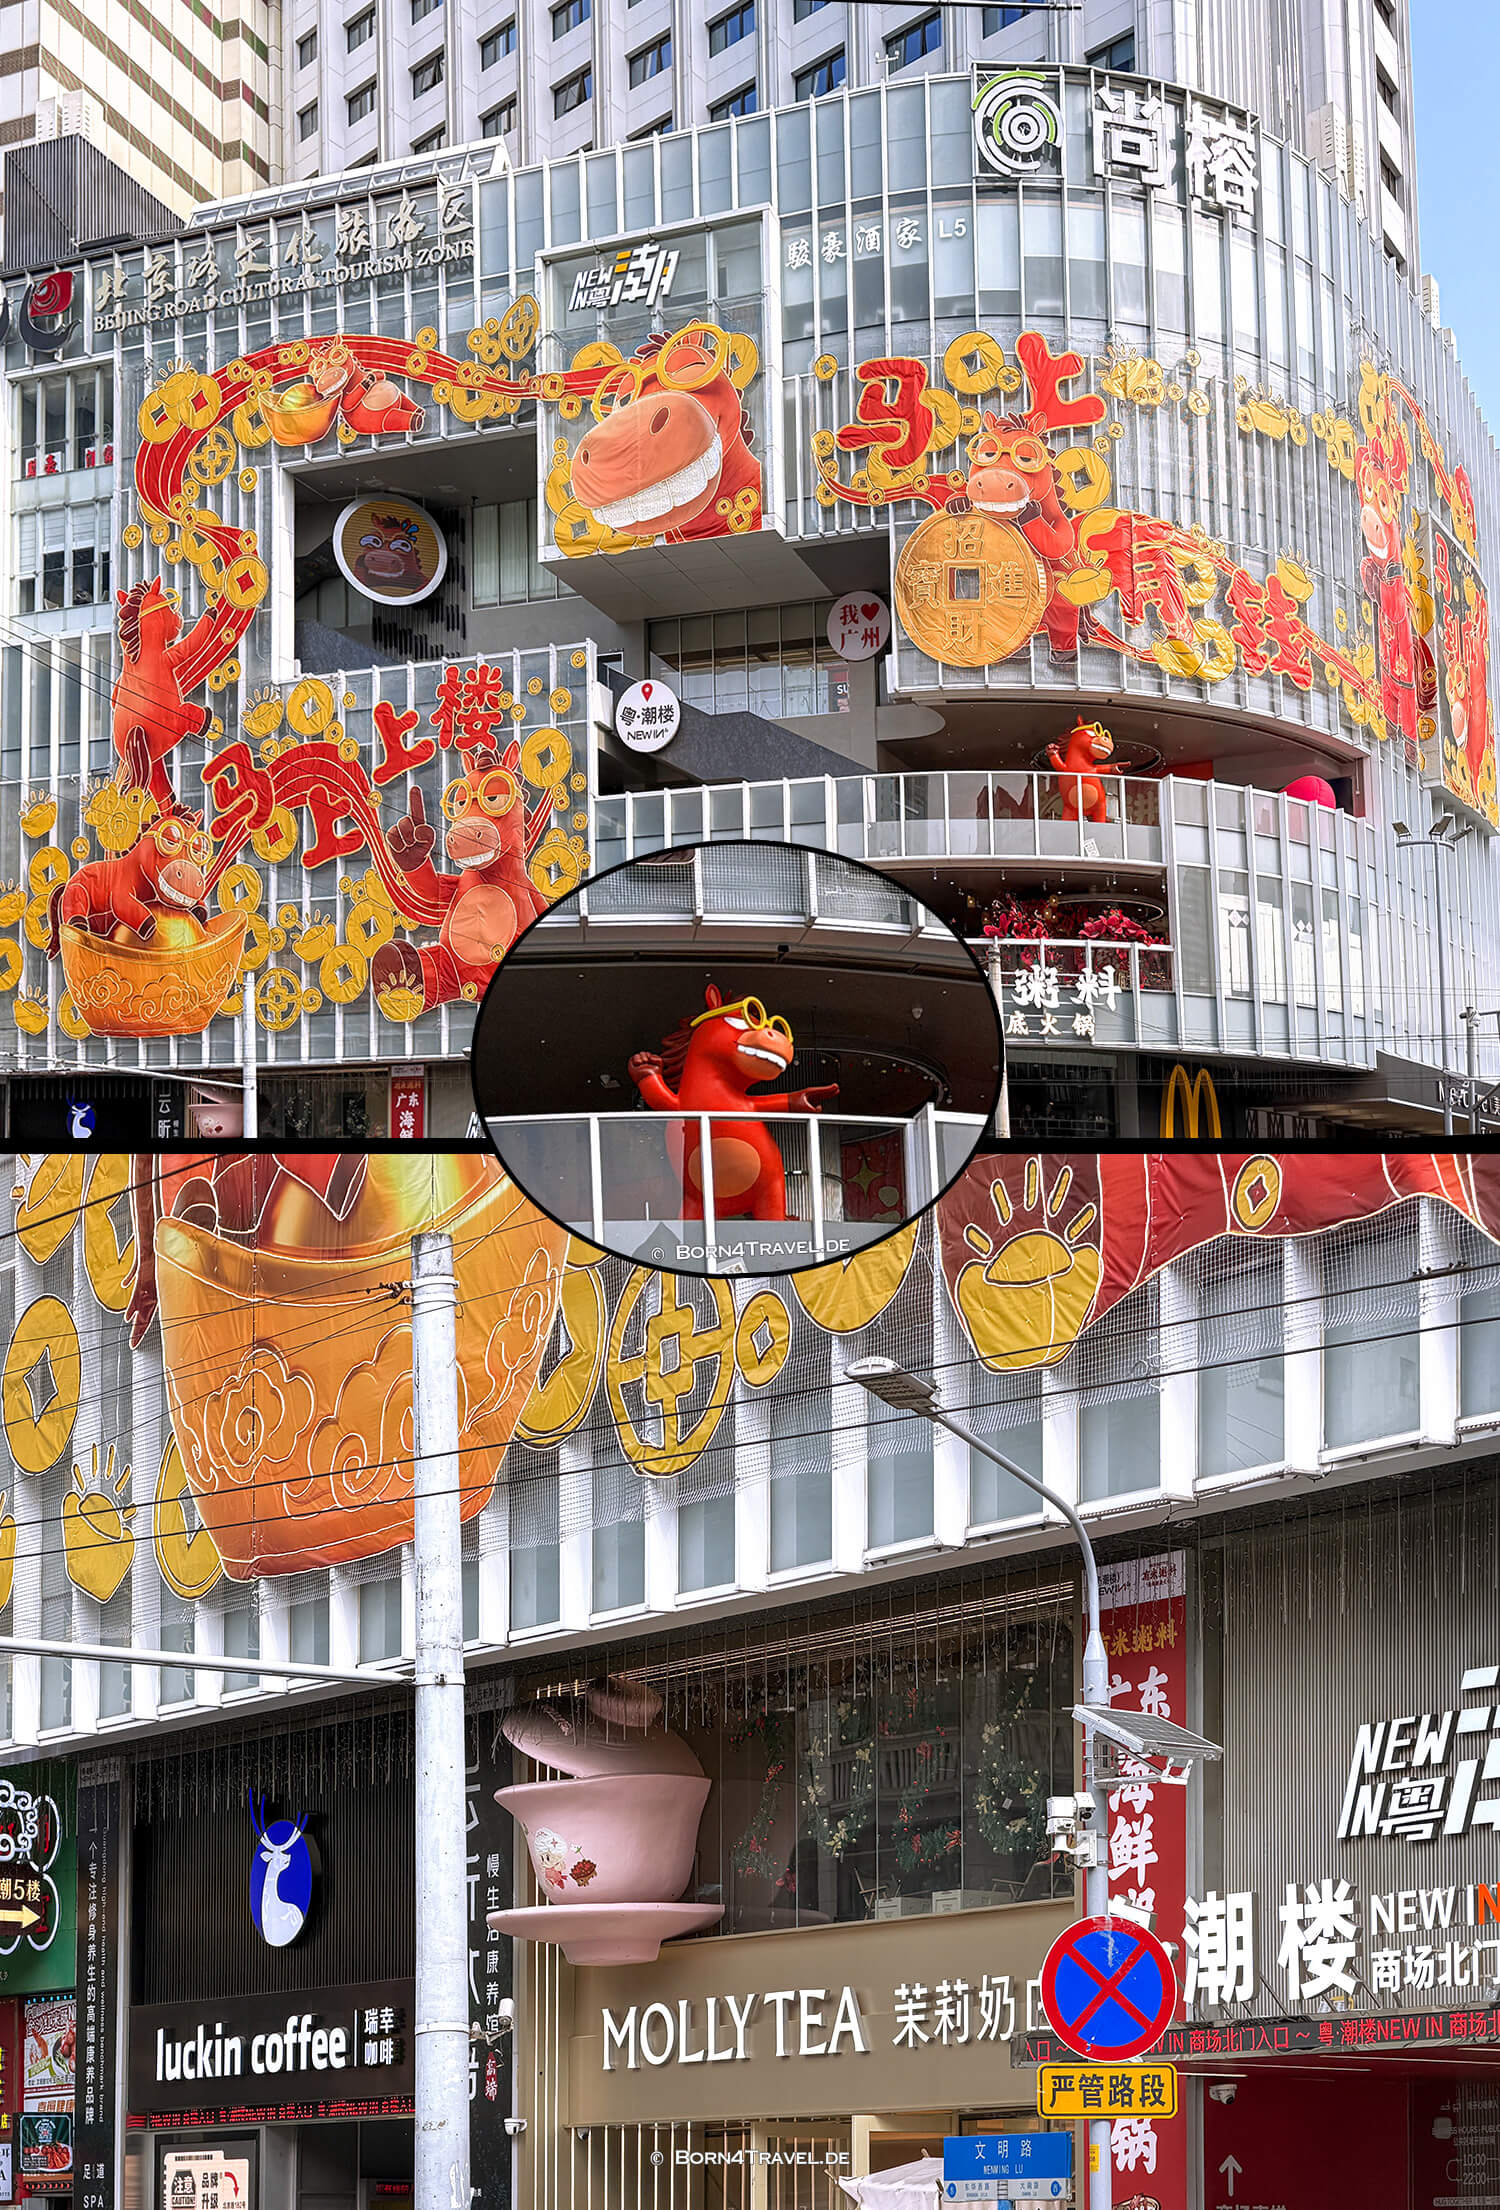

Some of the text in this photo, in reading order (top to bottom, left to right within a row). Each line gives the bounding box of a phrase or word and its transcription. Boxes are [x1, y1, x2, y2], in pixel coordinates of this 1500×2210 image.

[1093, 86, 1260, 215] 尚榕
[938, 218, 967, 240] L5
[94, 239, 476, 333] BEIJING ROAD CULTURAL TOURISM ZONE
[572, 265, 614, 290] NEW
[839, 603, 860, 626] 我
[839, 626, 881, 651] 广州
[620, 704, 675, 727] 粤·潮楼
[627, 730, 652, 741] NEW
[1011, 964, 1122, 1012] 粥料
[1006, 1010, 1095, 1037] 底火锅
[395, 1091, 420, 1108] 广东
[1354, 1711, 1454, 1774] NEW
[1370, 1886, 1457, 1935] NEW
[1182, 1878, 1360, 2005] 潮楼
[364, 2007, 394, 2035] 瑞幸
[602, 1986, 868, 2071] MOLLY TEA
[1190, 2025, 1289, 2053] 商场北门入口
[1426, 2015, 1443, 2038] IN
[156, 2014, 346, 2081] luckin coffee
[364, 2038, 394, 2066] 咖啡
[1049, 2073, 1166, 2109] 严管路段
[975, 2139, 1032, 2159] 文明路
[201, 2172, 219, 2188] 品牌
[983, 2163, 1024, 2175] WENMING LU
[174, 2175, 194, 2194] 注意
[83, 2195, 104, 2208] SPA
[201, 2193, 219, 2209] 升级
